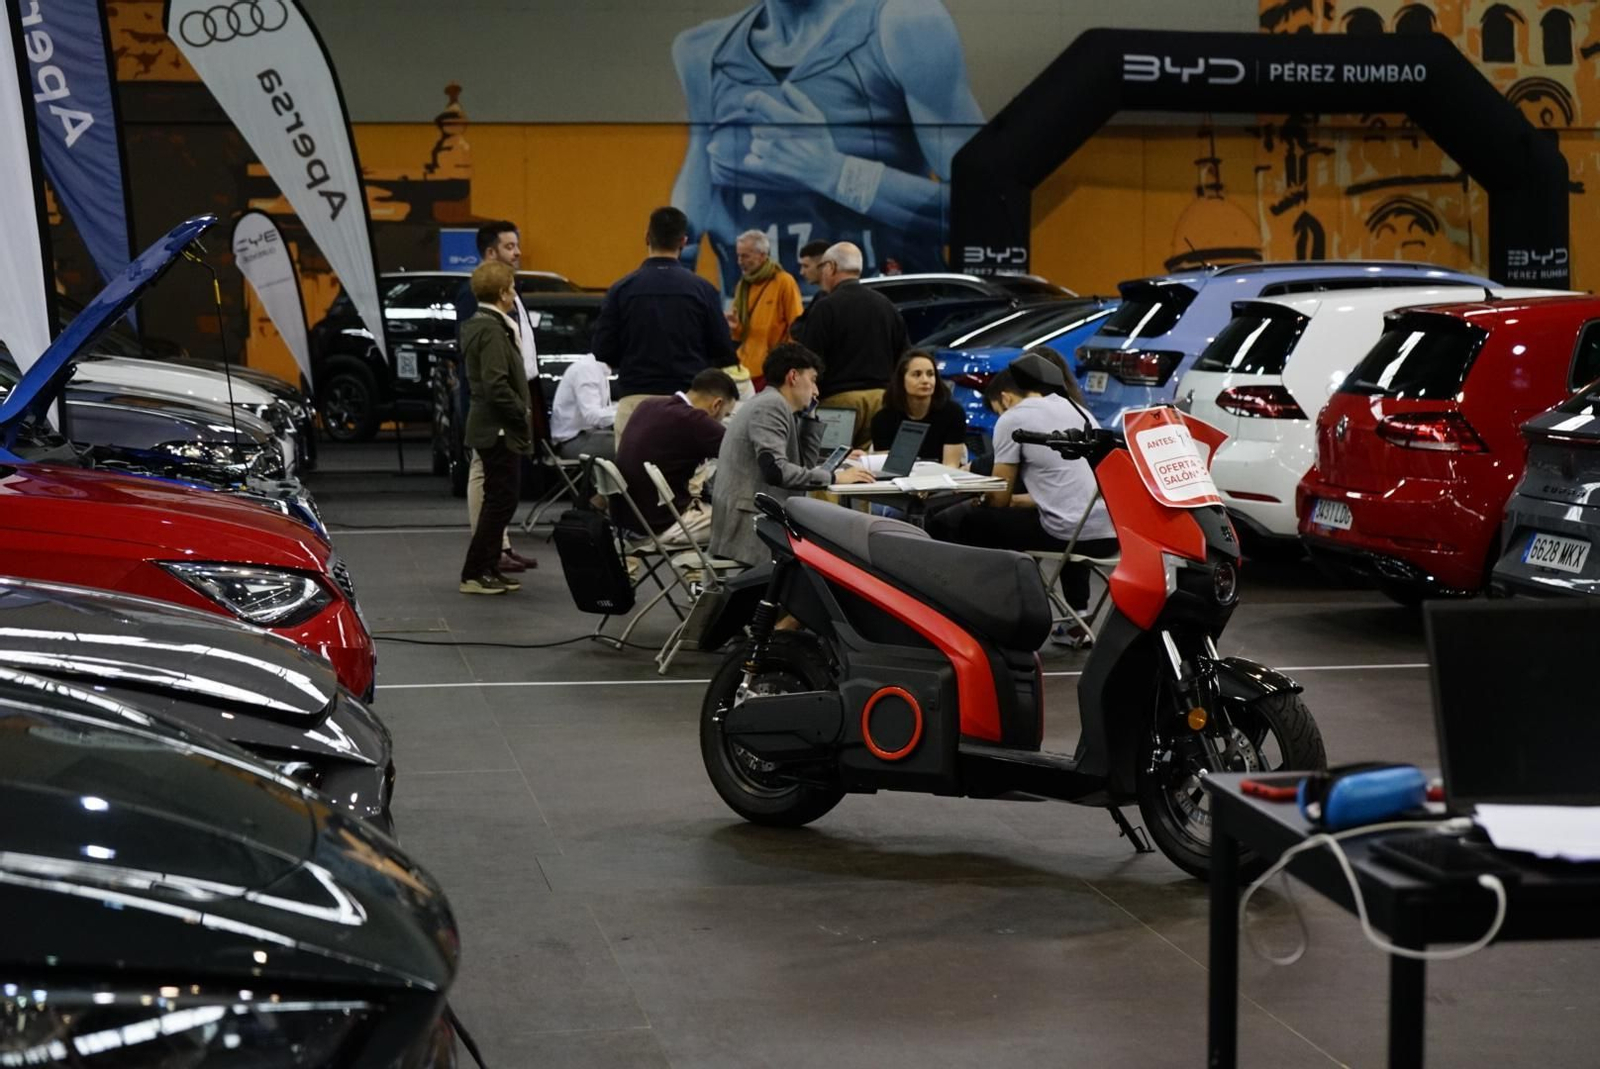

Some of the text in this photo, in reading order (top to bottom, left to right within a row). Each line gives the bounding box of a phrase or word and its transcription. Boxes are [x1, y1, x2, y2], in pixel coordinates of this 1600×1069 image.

[1123, 54, 1427, 85] BYD PÉREZ RUMBAO
[963, 246, 1027, 263] BYD
[1507, 247, 1568, 267] BYD
[1158, 460, 1197, 476] OFERTA
[1530, 537, 1587, 569] 6628 MKX
